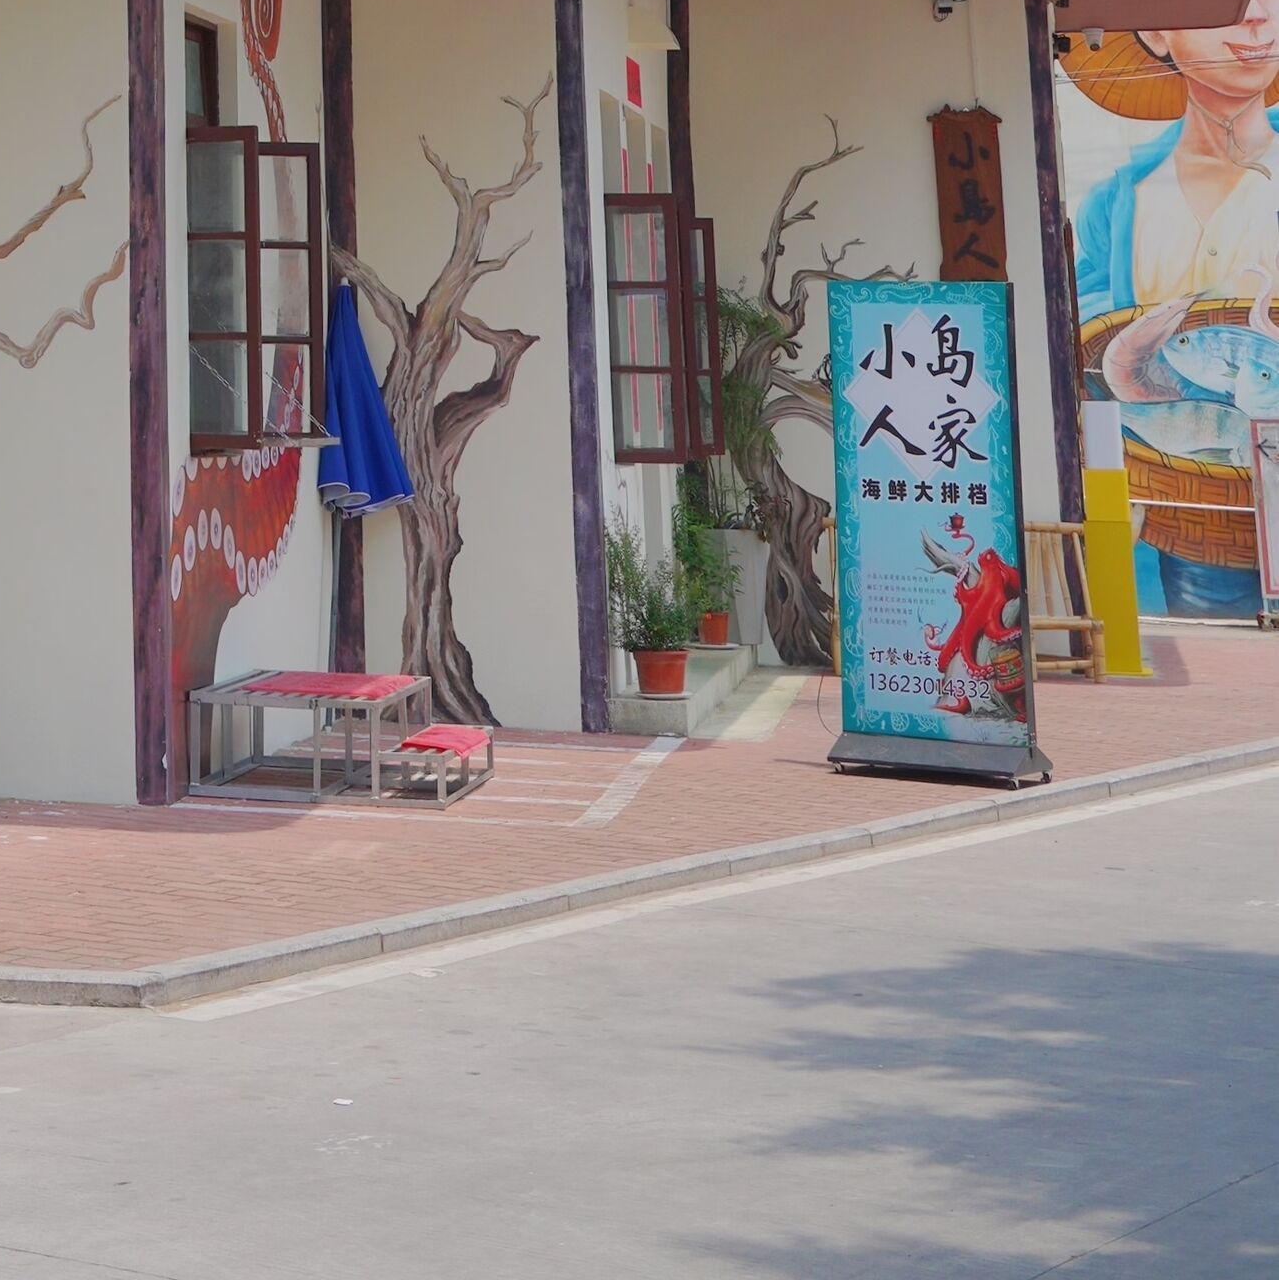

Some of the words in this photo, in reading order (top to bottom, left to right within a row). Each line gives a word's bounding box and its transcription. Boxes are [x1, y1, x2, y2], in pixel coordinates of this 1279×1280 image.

[948, 131, 1000, 280] 小岛人
[861, 478, 988, 506] 海鲜大排档
[869, 673, 990, 699] 13623014332
